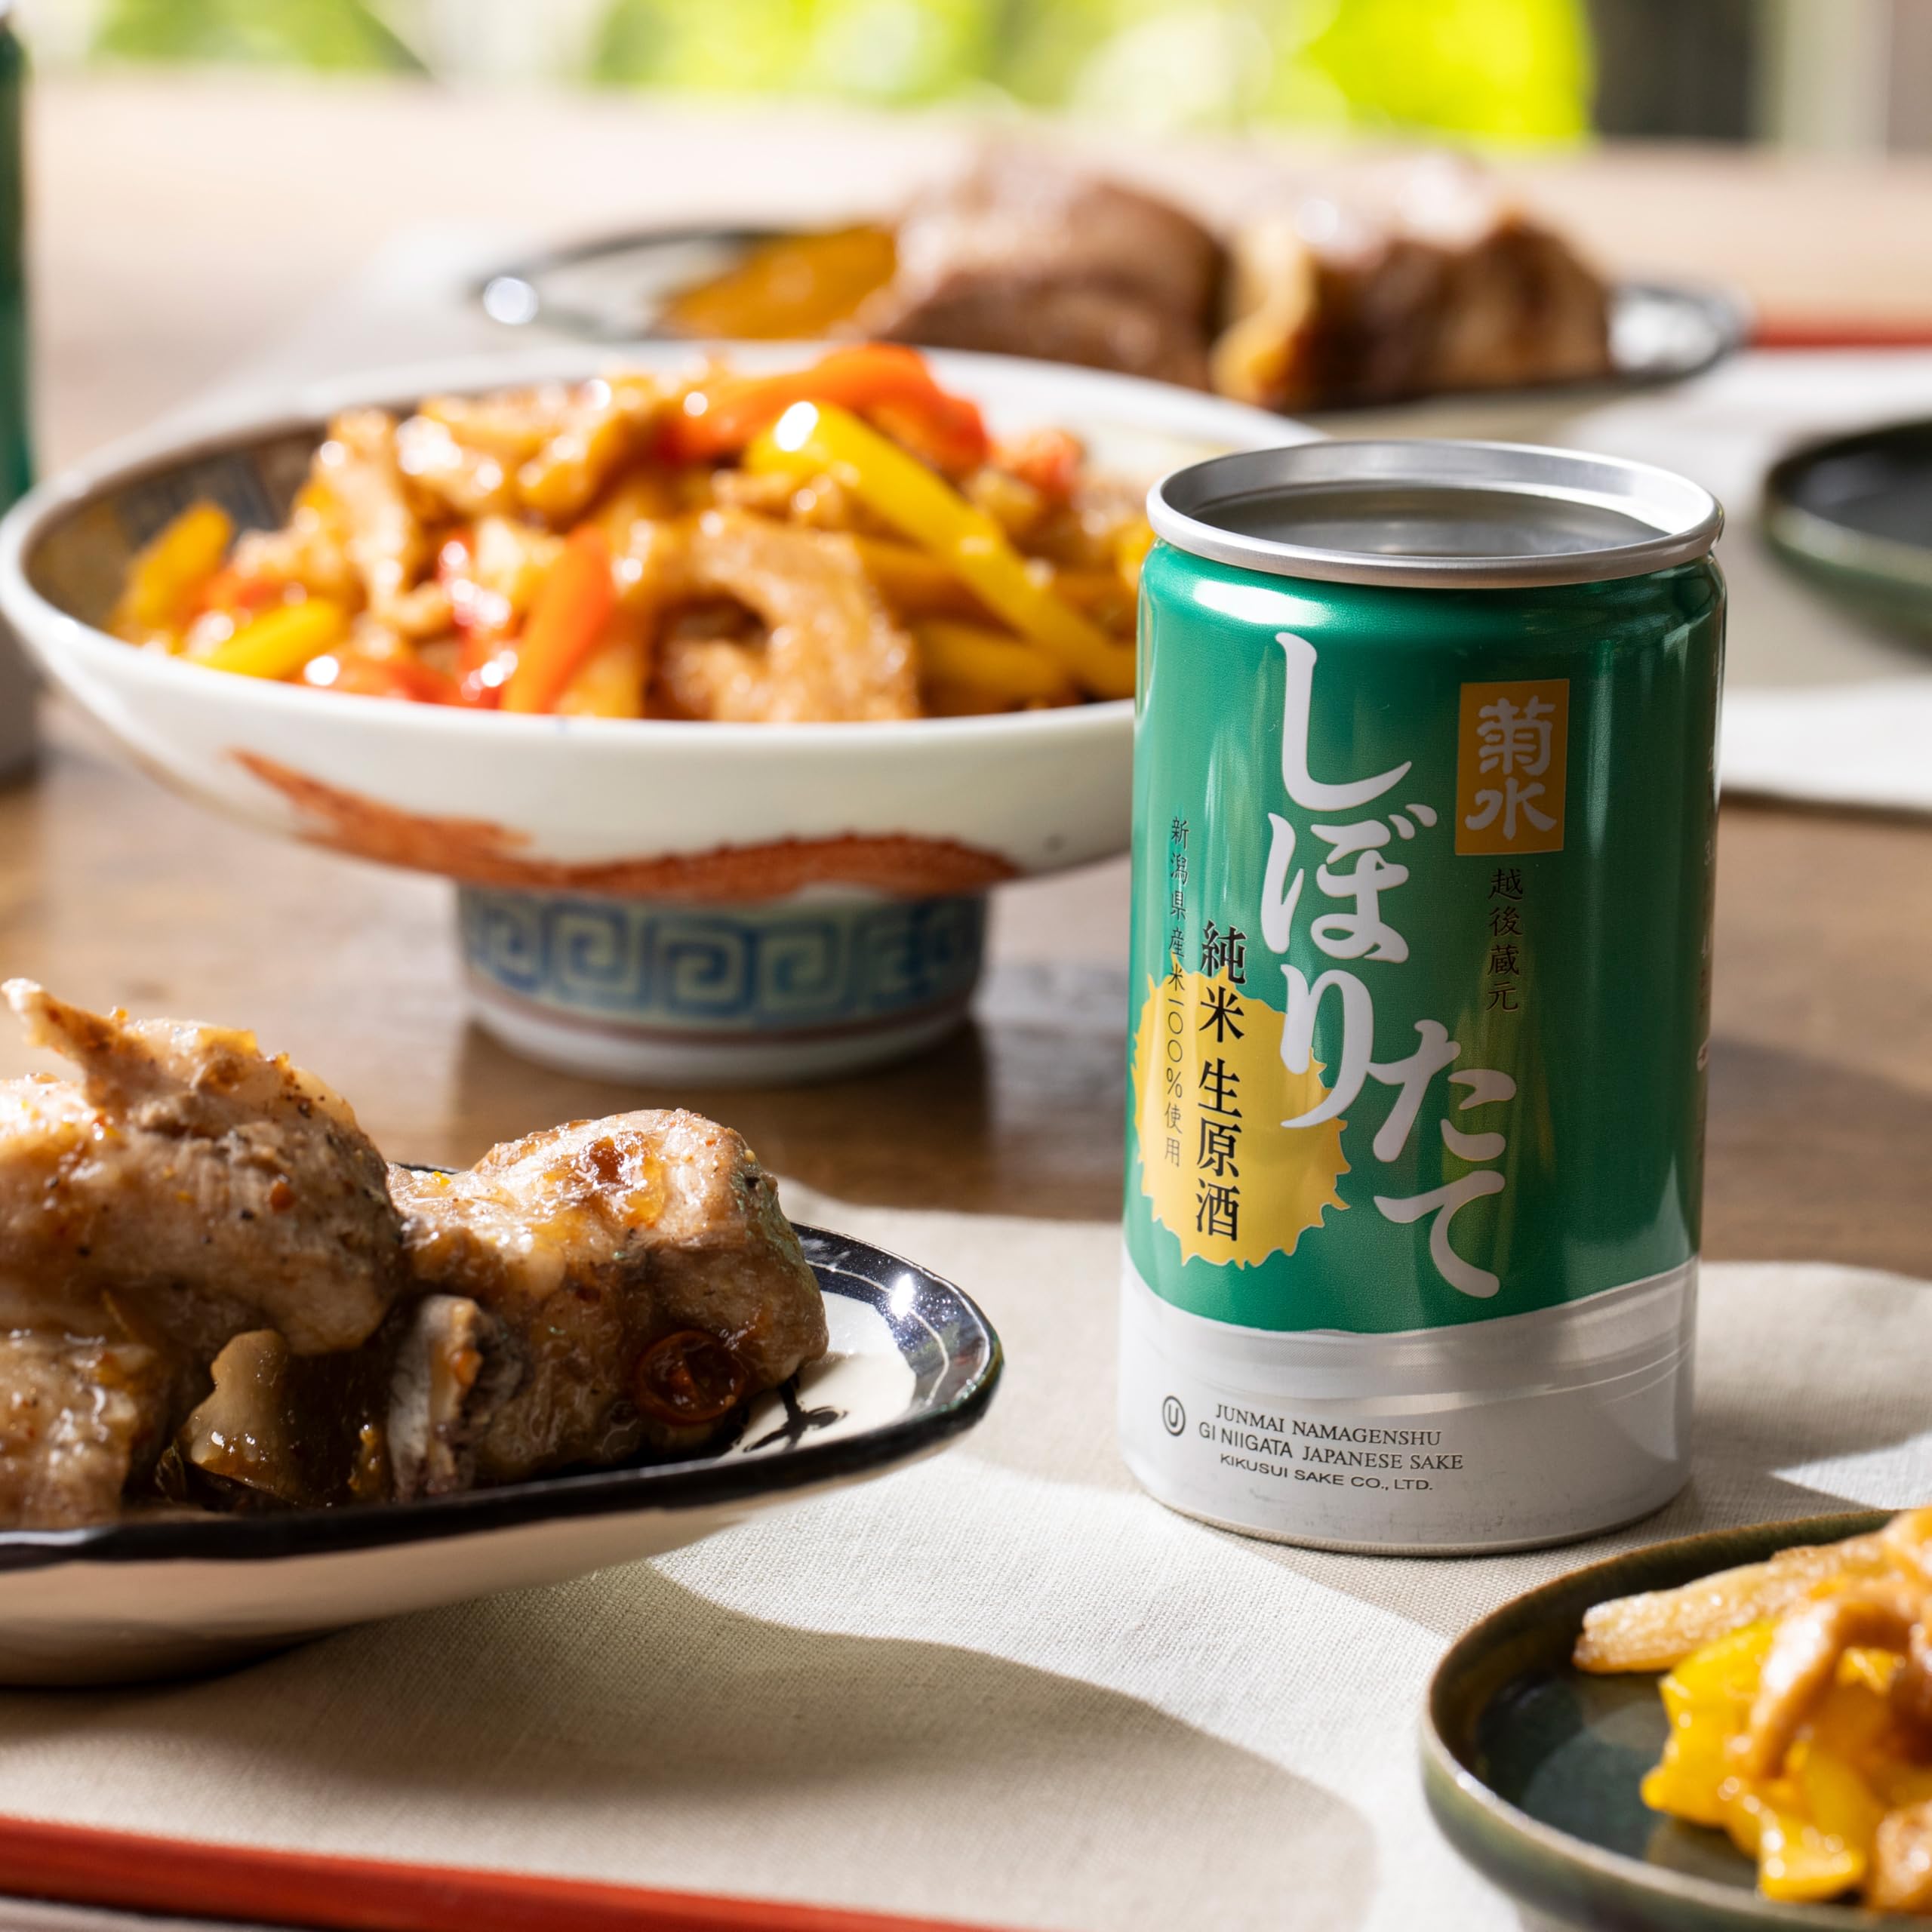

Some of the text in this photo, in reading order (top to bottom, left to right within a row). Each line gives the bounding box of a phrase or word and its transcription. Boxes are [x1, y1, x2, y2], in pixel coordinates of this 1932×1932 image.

[1464, 694, 1558, 841] 菊水
[1260, 631, 1517, 1298] しぼりたて
[1485, 867, 1524, 1014] 越後蔵元
[1198, 1421, 1463, 1470] GI NIIGATA JAPANESE SAKE
[1216, 1404, 1442, 1446] JUNMAI NAMAGENSHU
[1220, 1454, 1433, 1491] KIKUSUI SAKE CO., LTD.
